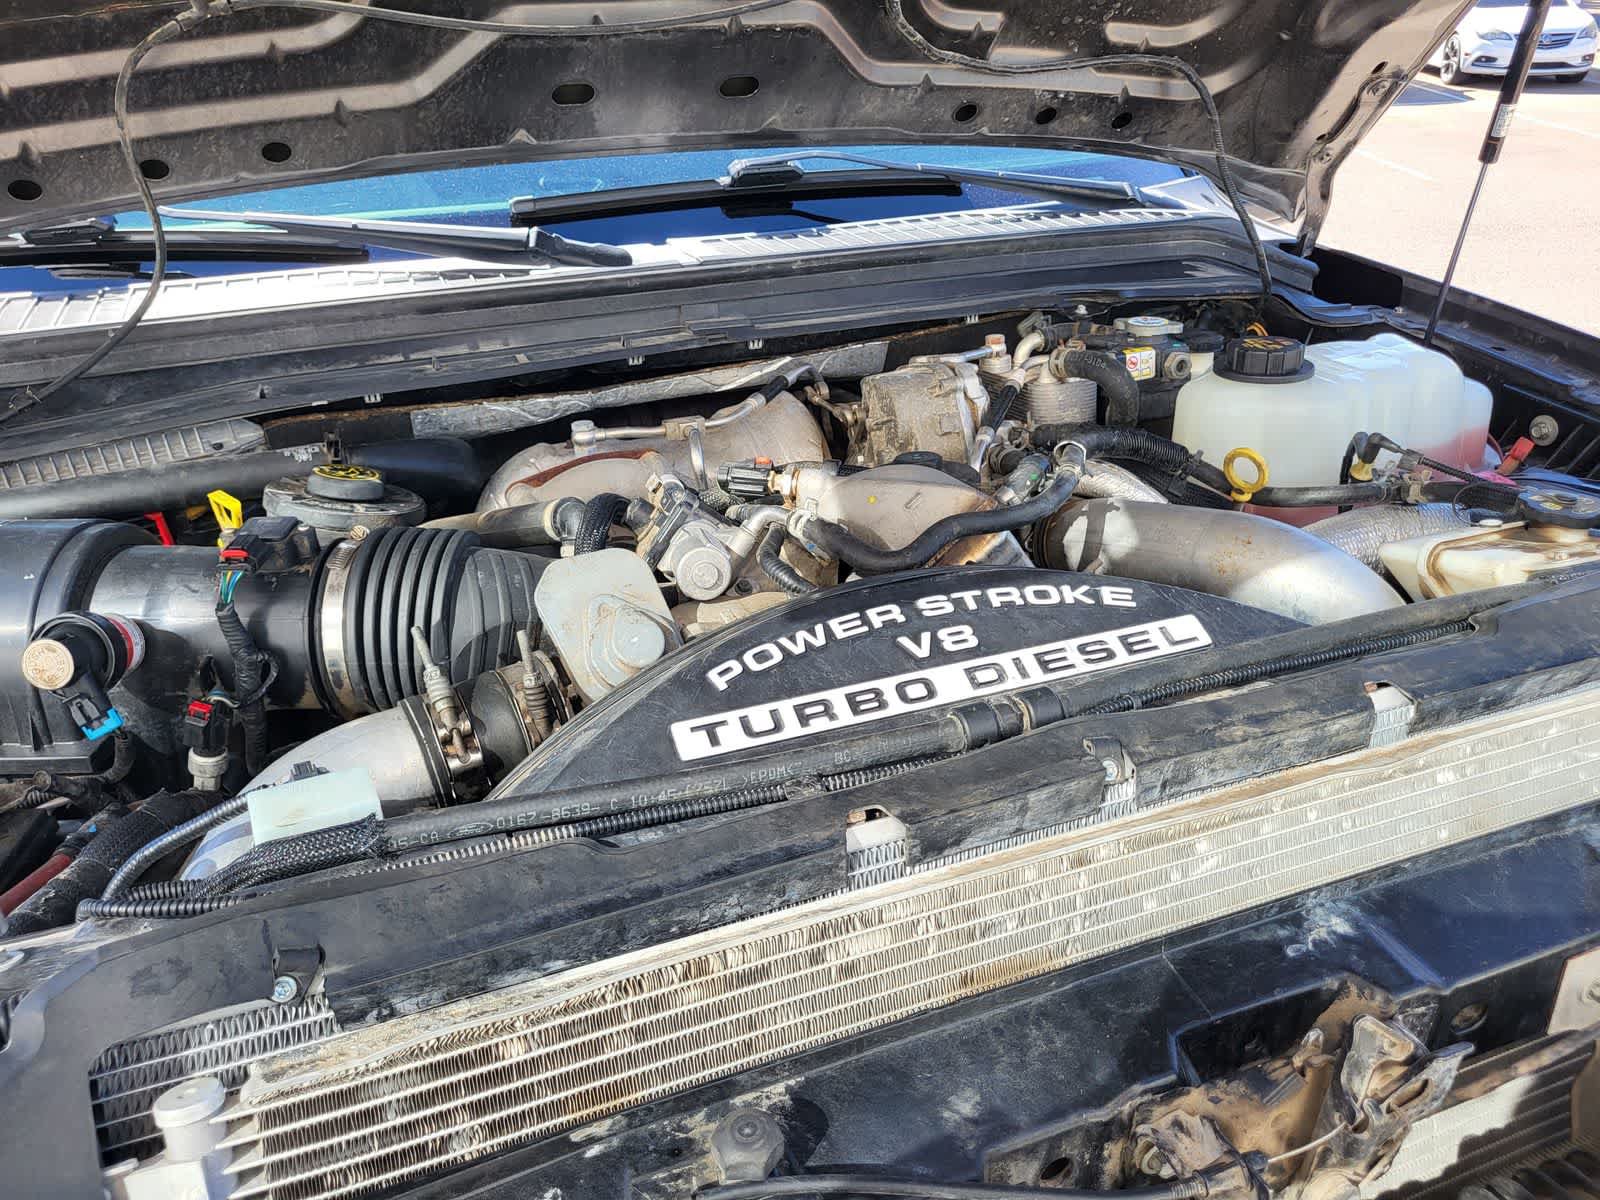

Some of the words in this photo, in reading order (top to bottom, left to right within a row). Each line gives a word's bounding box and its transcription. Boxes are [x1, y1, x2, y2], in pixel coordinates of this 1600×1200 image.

[690, 676, 937, 748] TURBO
[964, 624, 1200, 690] DIESEL
[705, 603, 906, 691] POWER
[914, 584, 1137, 616] STROKE
[898, 624, 979, 659] V8
